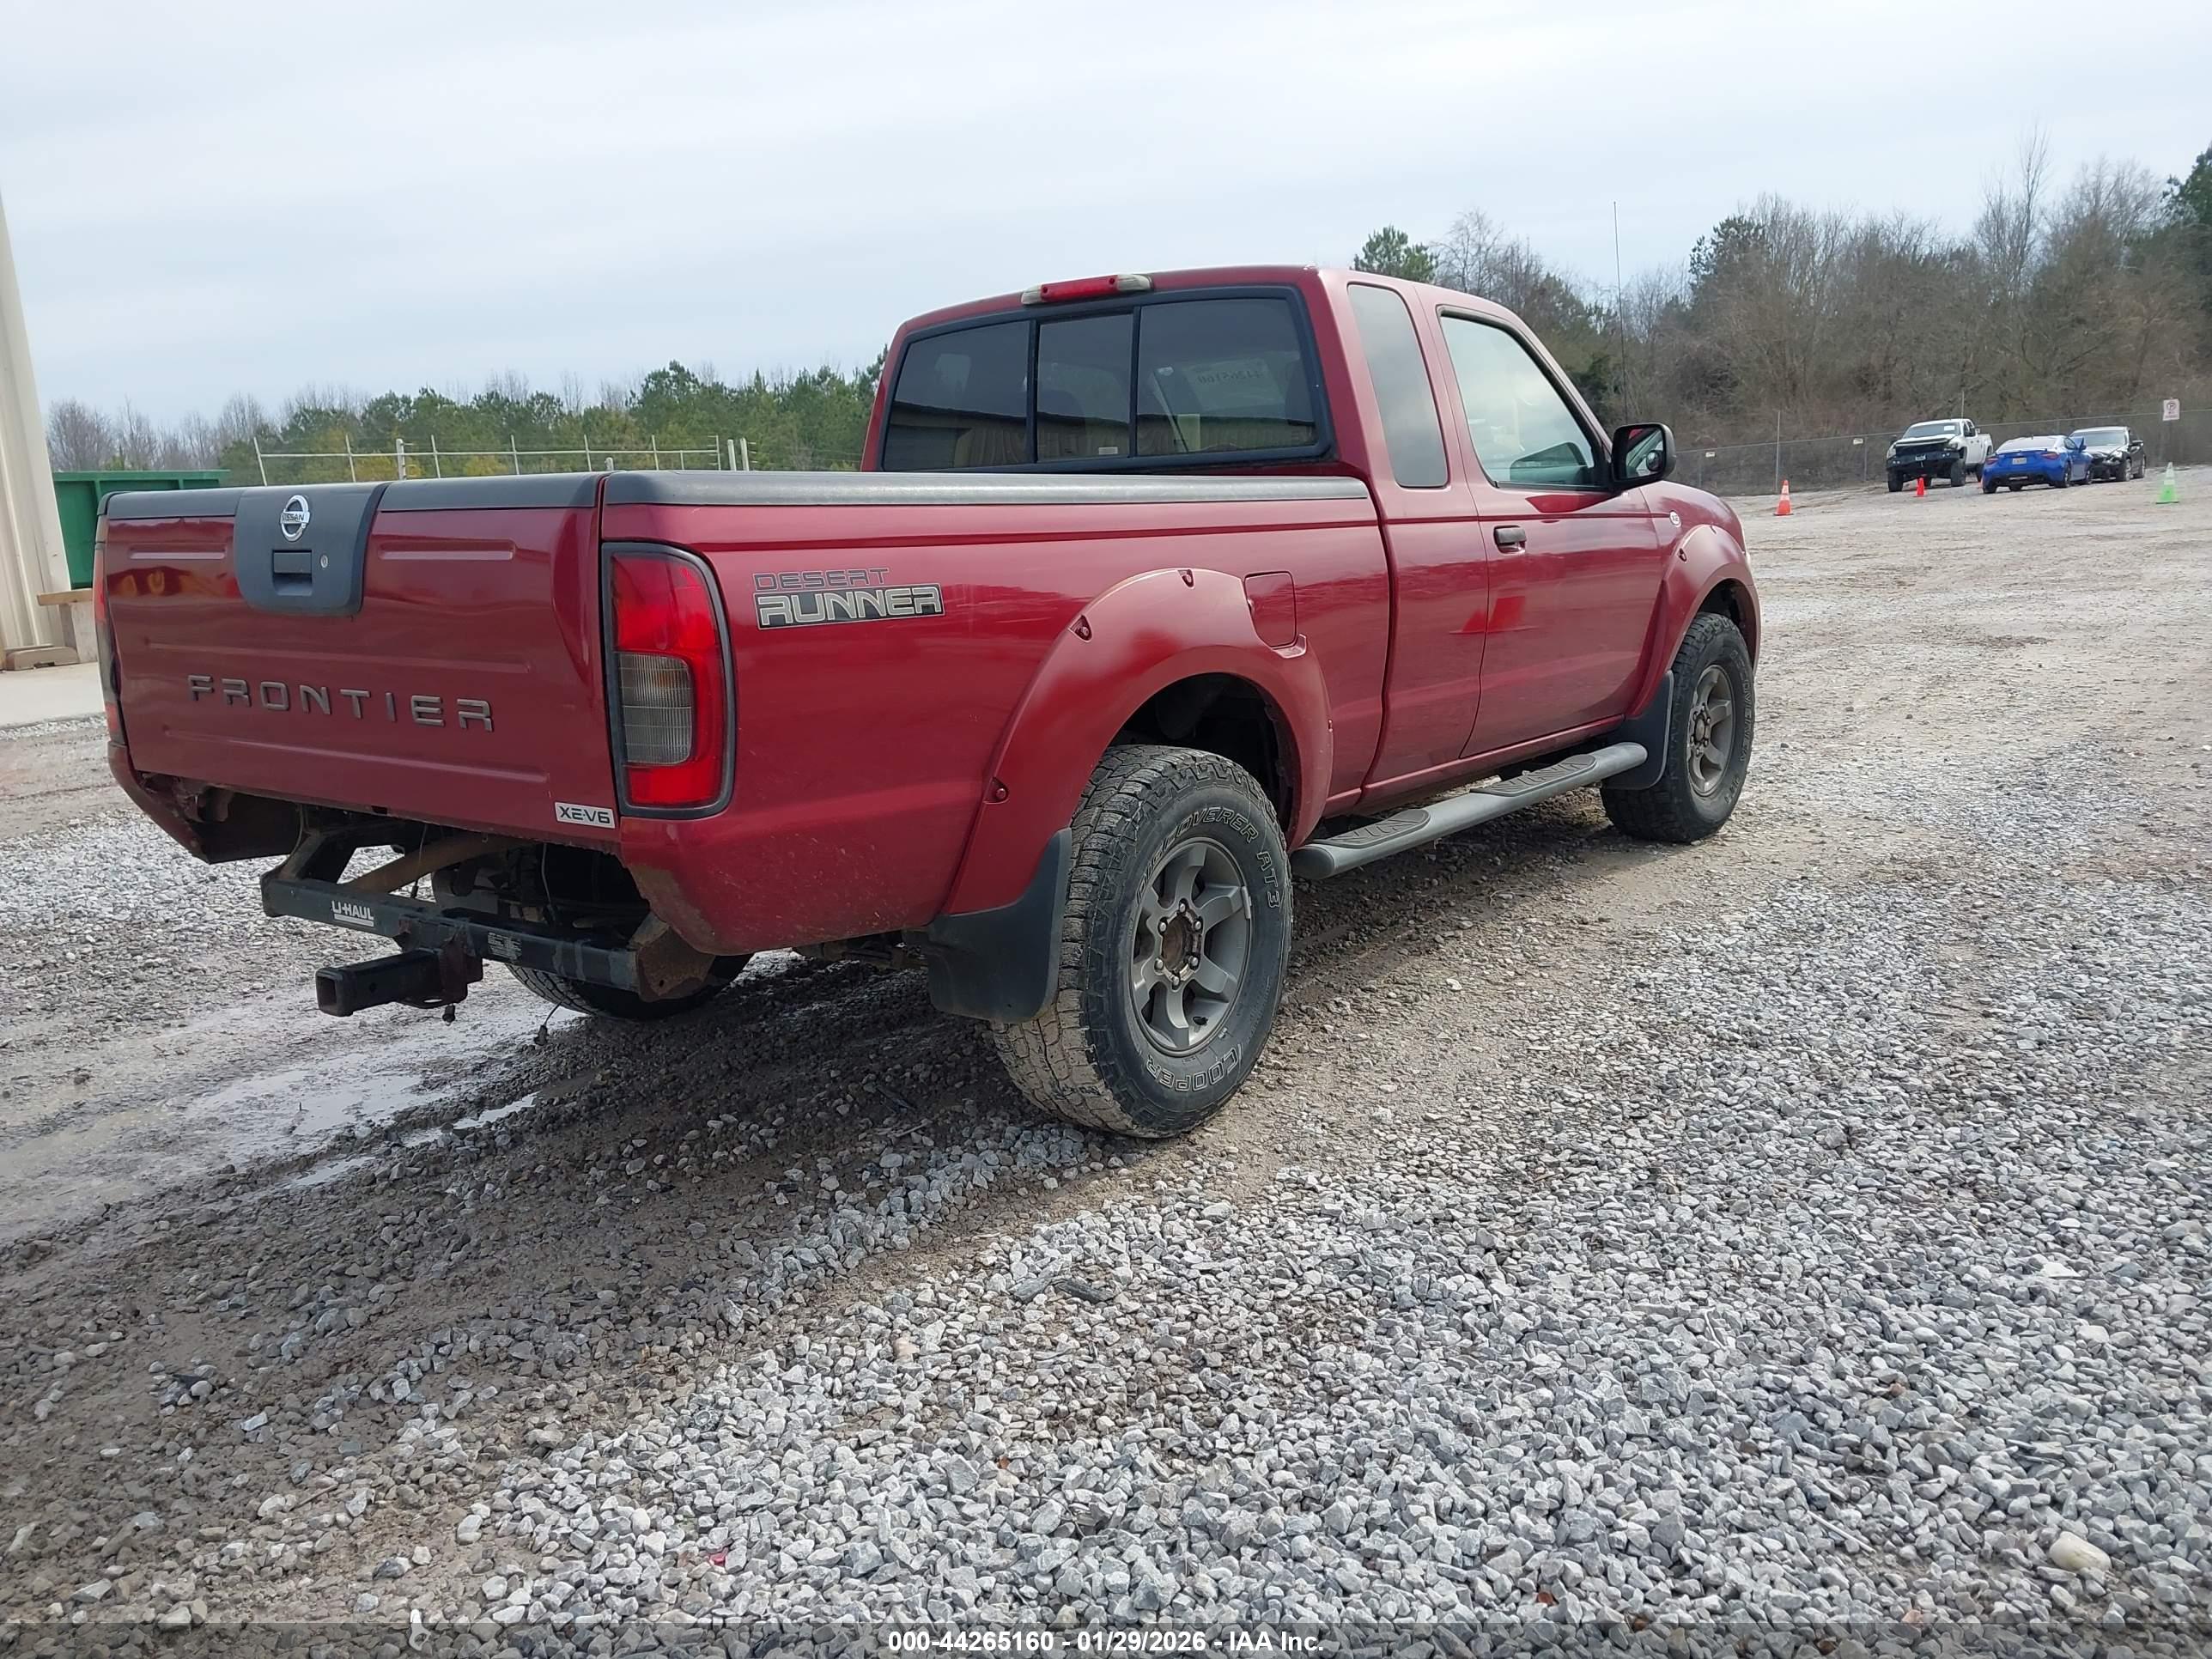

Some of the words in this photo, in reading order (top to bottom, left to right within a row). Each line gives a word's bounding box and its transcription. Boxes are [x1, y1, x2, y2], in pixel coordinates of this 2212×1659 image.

[754, 568, 890, 592] DESERT
[757, 586, 943, 626] RUNNER
[187, 674, 494, 732] FRONTIER
[1135, 806, 1259, 905] DISCOVERER
[331, 900, 374, 921] U-HAUL
[1146, 1047, 1238, 1092] COOPER
